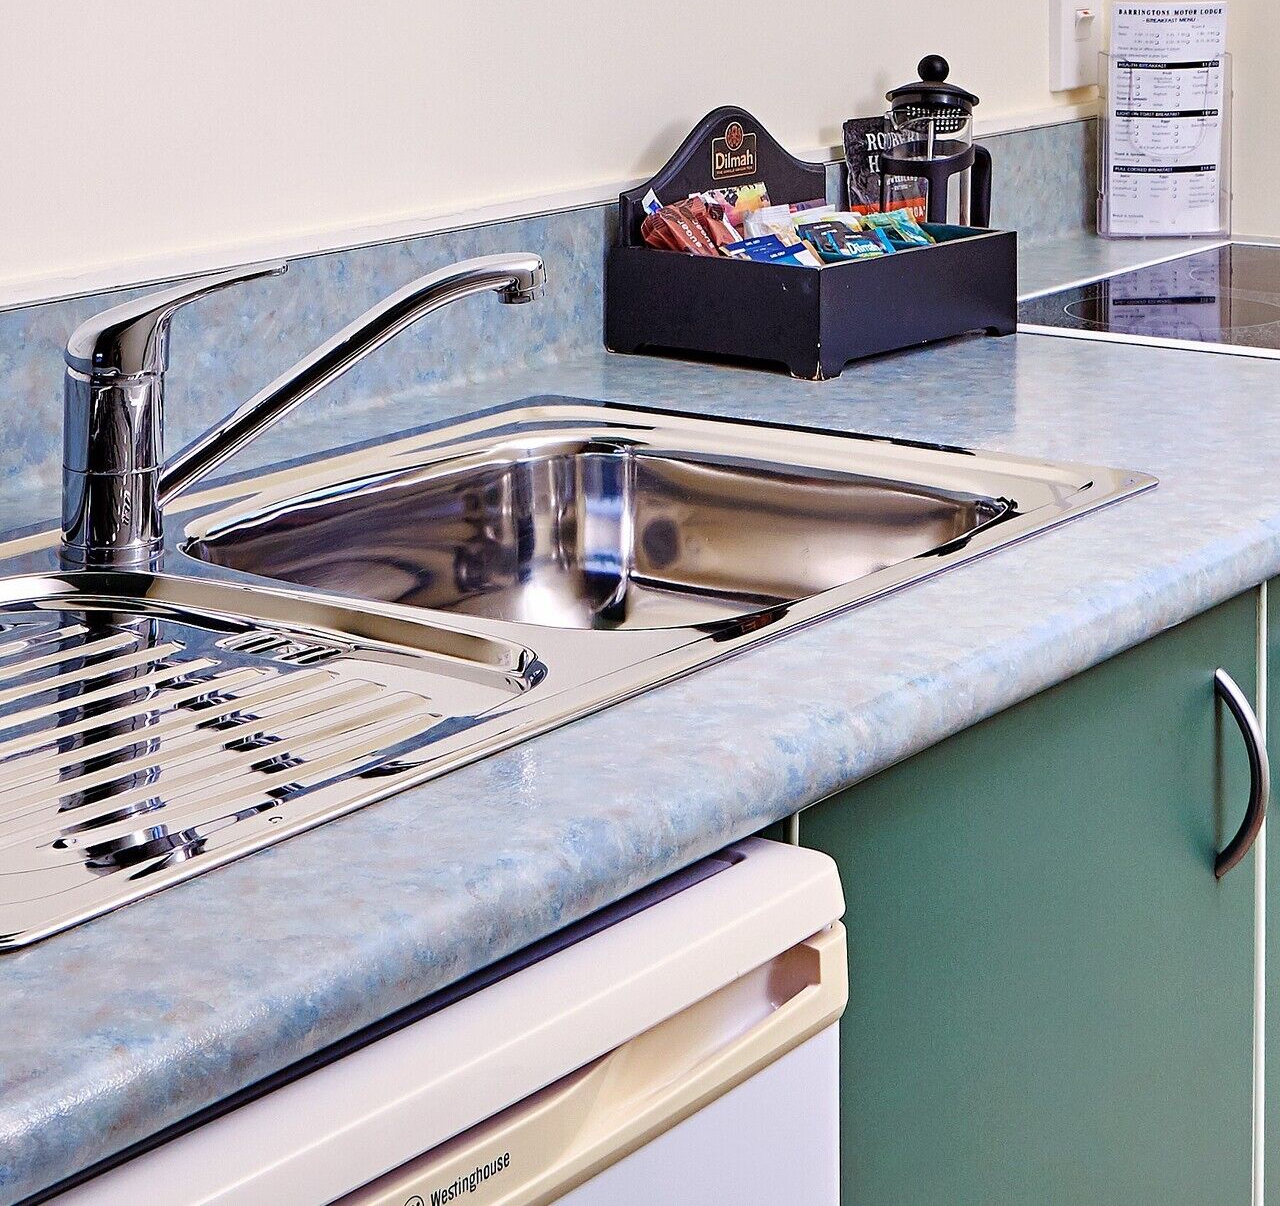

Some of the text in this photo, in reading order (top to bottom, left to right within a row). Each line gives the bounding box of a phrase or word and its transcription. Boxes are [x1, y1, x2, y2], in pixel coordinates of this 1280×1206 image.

[1118, 8, 1170, 16] BARRINGTONS
[715, 149, 754, 170] Dilmah
[430, 1152, 511, 1206] Westinghouse
